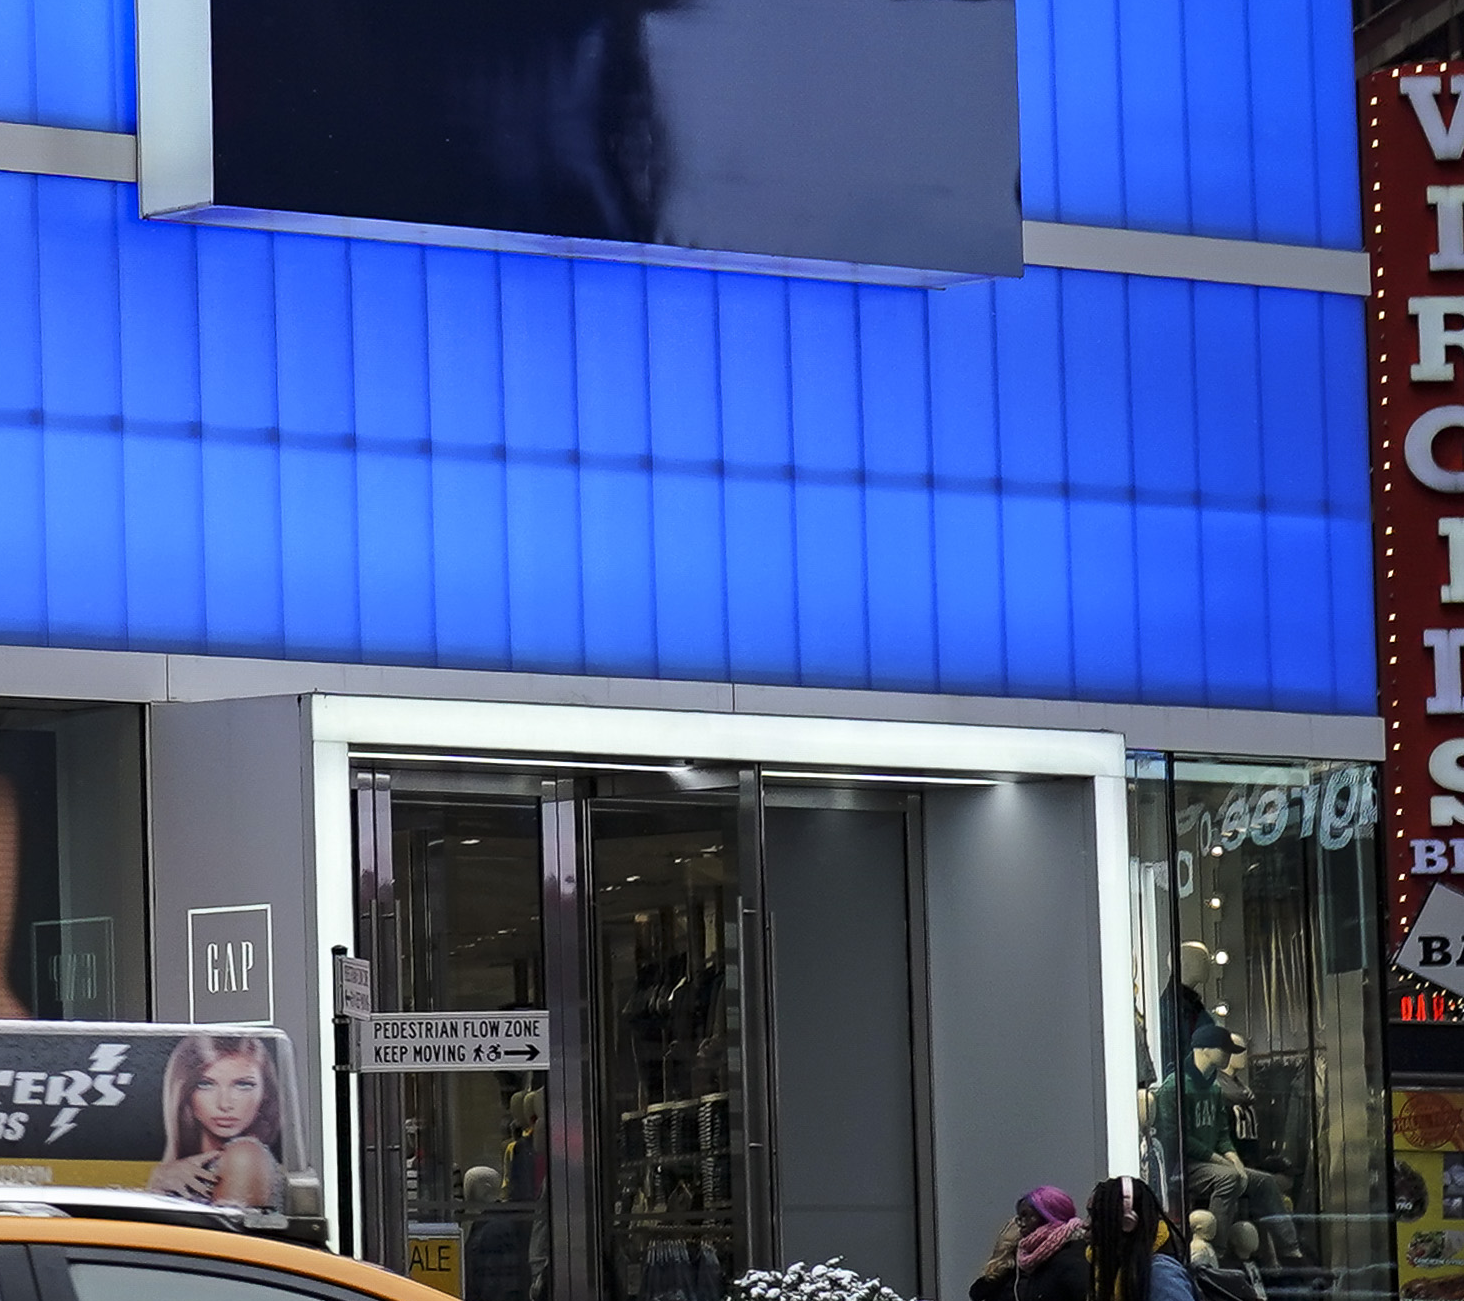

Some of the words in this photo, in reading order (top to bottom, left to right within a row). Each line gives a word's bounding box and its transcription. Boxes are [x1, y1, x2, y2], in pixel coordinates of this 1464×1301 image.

[207, 941, 254, 994] GAP
[373, 1020, 459, 1040] PEDESTRIAN
[463, 1020, 500, 1039] FLOW
[504, 1019, 541, 1038] ZONE
[373, 1045, 408, 1063] KEEP
[412, 1044, 467, 1063] MOVING
[409, 1245, 452, 1272] ALE
